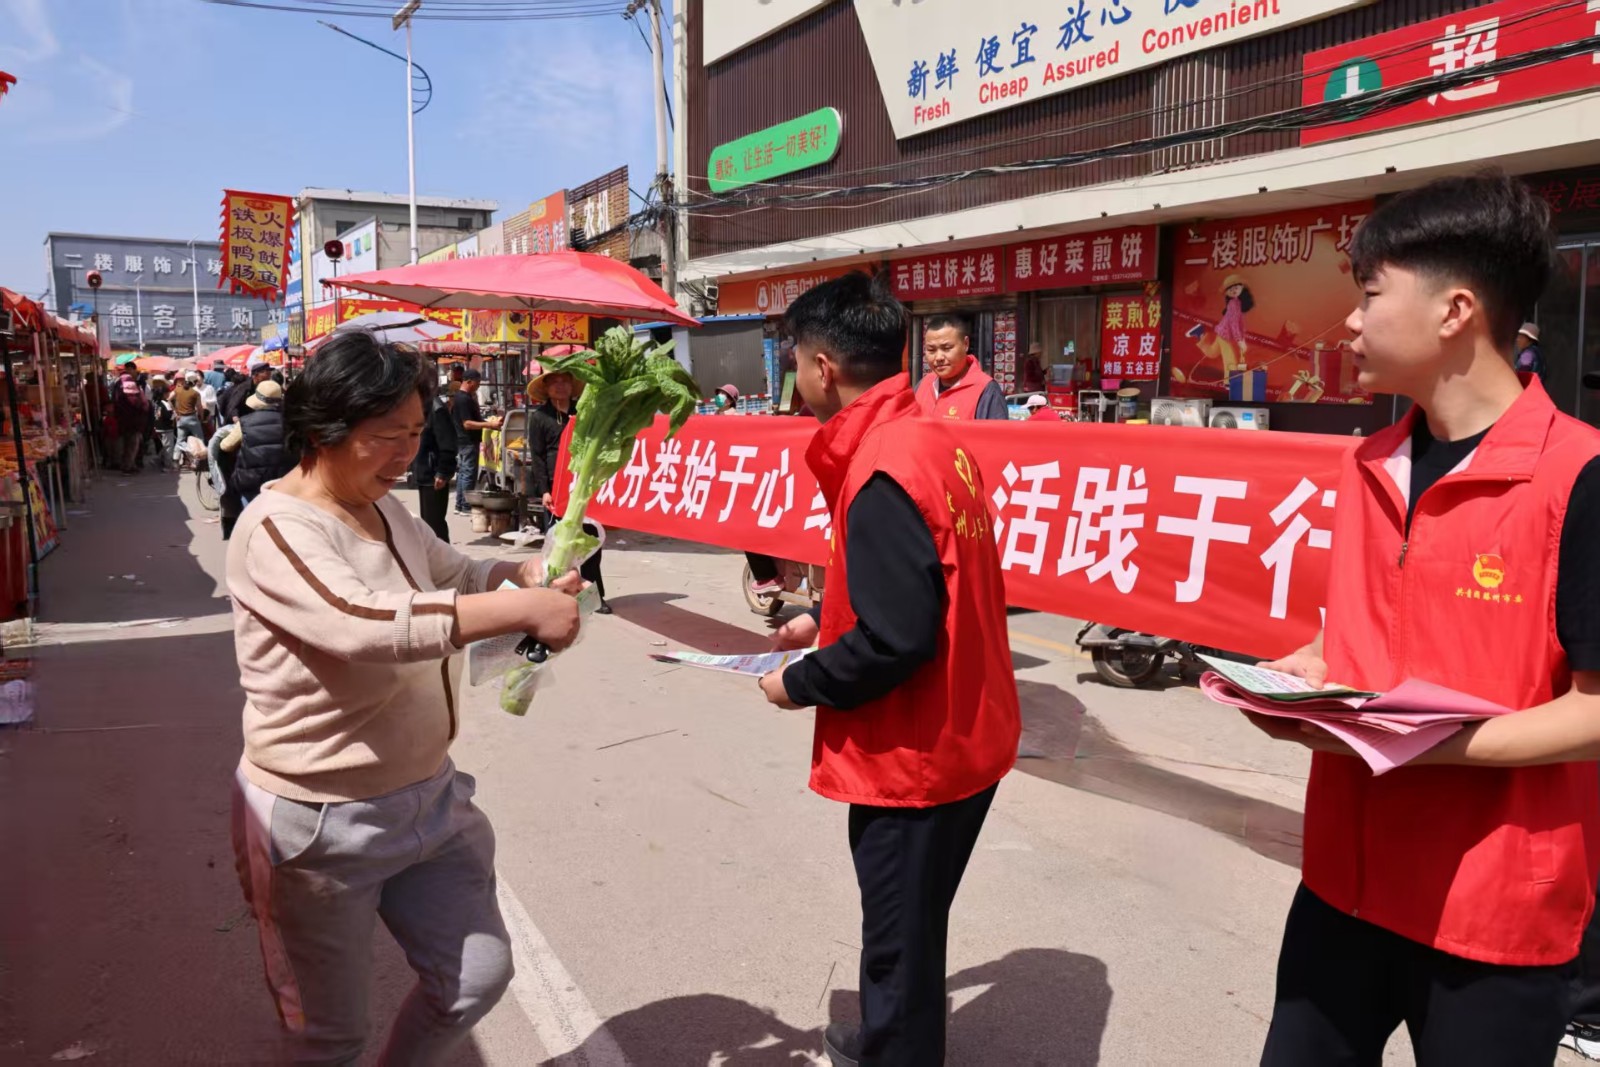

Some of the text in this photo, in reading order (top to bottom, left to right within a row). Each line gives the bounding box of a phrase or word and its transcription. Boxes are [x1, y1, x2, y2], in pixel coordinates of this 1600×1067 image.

[907, 0, 1132, 100] 新鲜 便宜 放心
[914, 97, 951, 125] Fresh
[978, 75, 1029, 105] Cheap
[1043, 41, 1119, 85] Assured
[1142, 0, 1281, 54] Convenient
[230, 207, 257, 280] 铁板鸭肠
[258, 212, 285, 289] 火爆鱿鱼
[897, 253, 995, 291] 云南过桥米线
[1015, 233, 1143, 278] 惠好菜煎饼
[1184, 214, 1367, 269] 二楼服饰广场
[1106, 301, 1161, 330] 菜煎饼
[1112, 333, 1156, 357] 凉皮
[568, 438, 795, 528] 分类始于心
